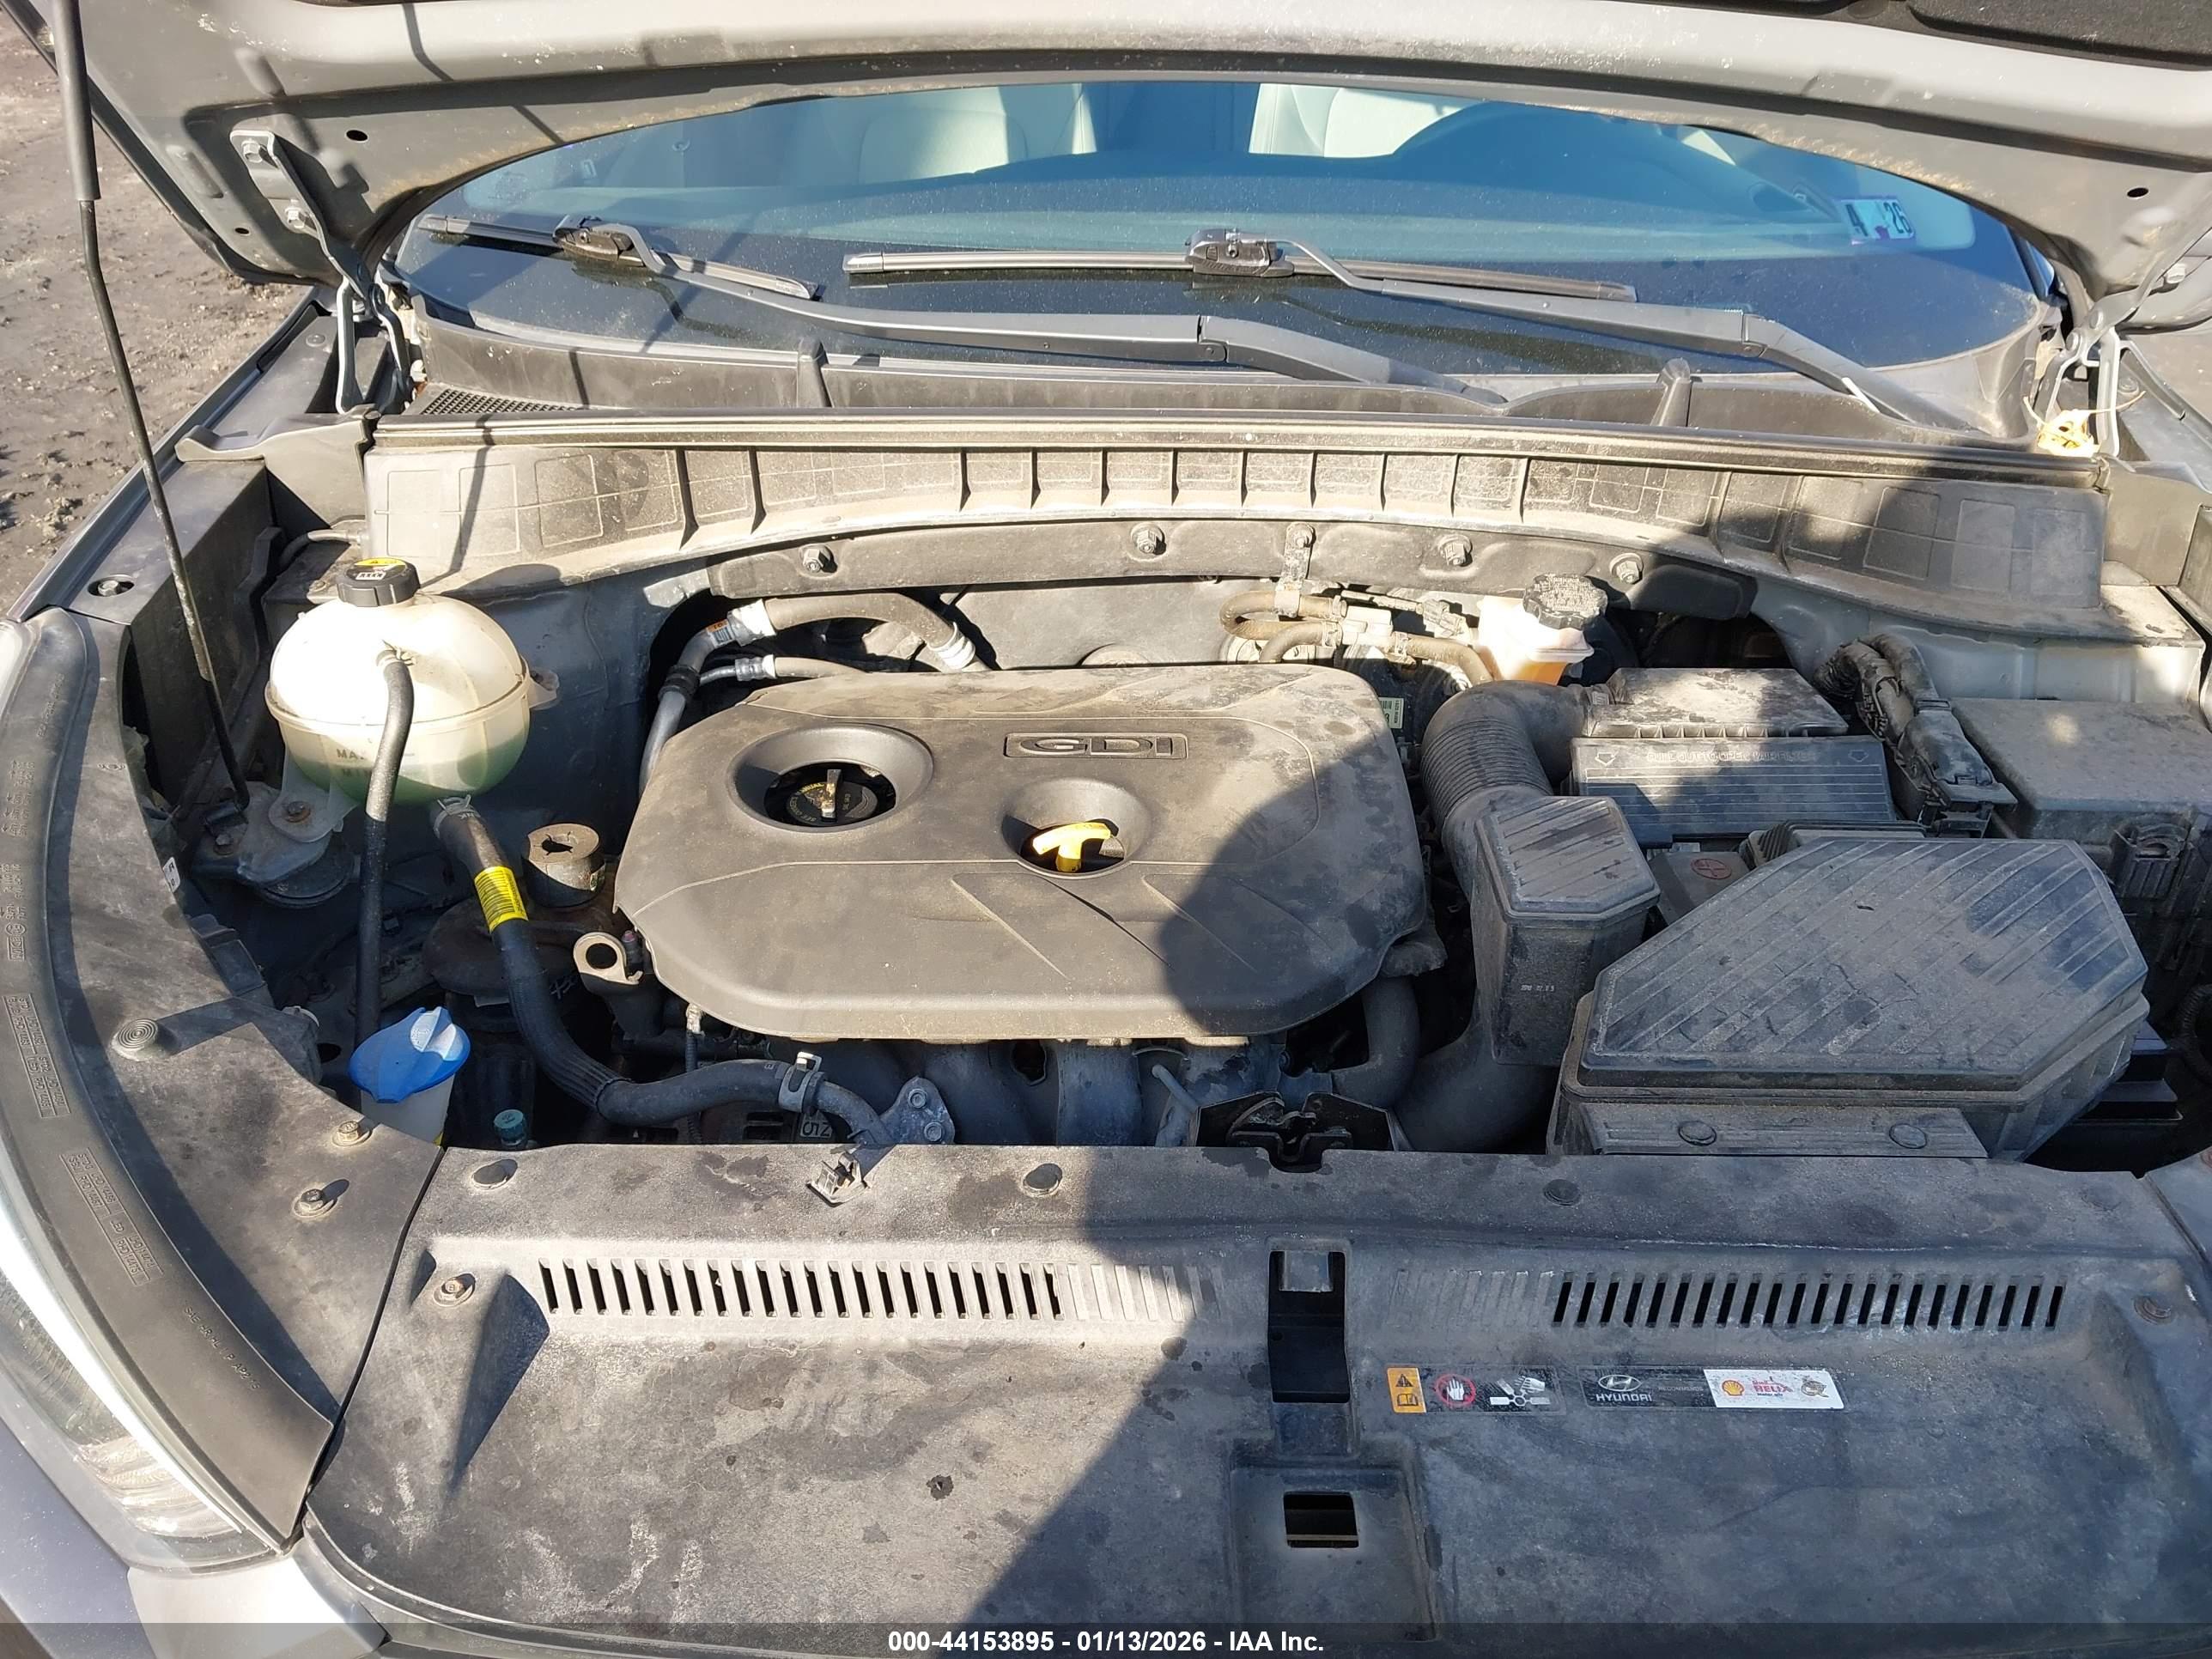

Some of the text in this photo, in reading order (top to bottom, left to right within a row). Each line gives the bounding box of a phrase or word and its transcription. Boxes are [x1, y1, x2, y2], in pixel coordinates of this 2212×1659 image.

[1844, 201, 1913, 237] 4 26
[1019, 737, 1174, 757] GDI
[184, 1306, 200, 1323] SAE
[1595, 1393, 1653, 1402] HYUNDAI
